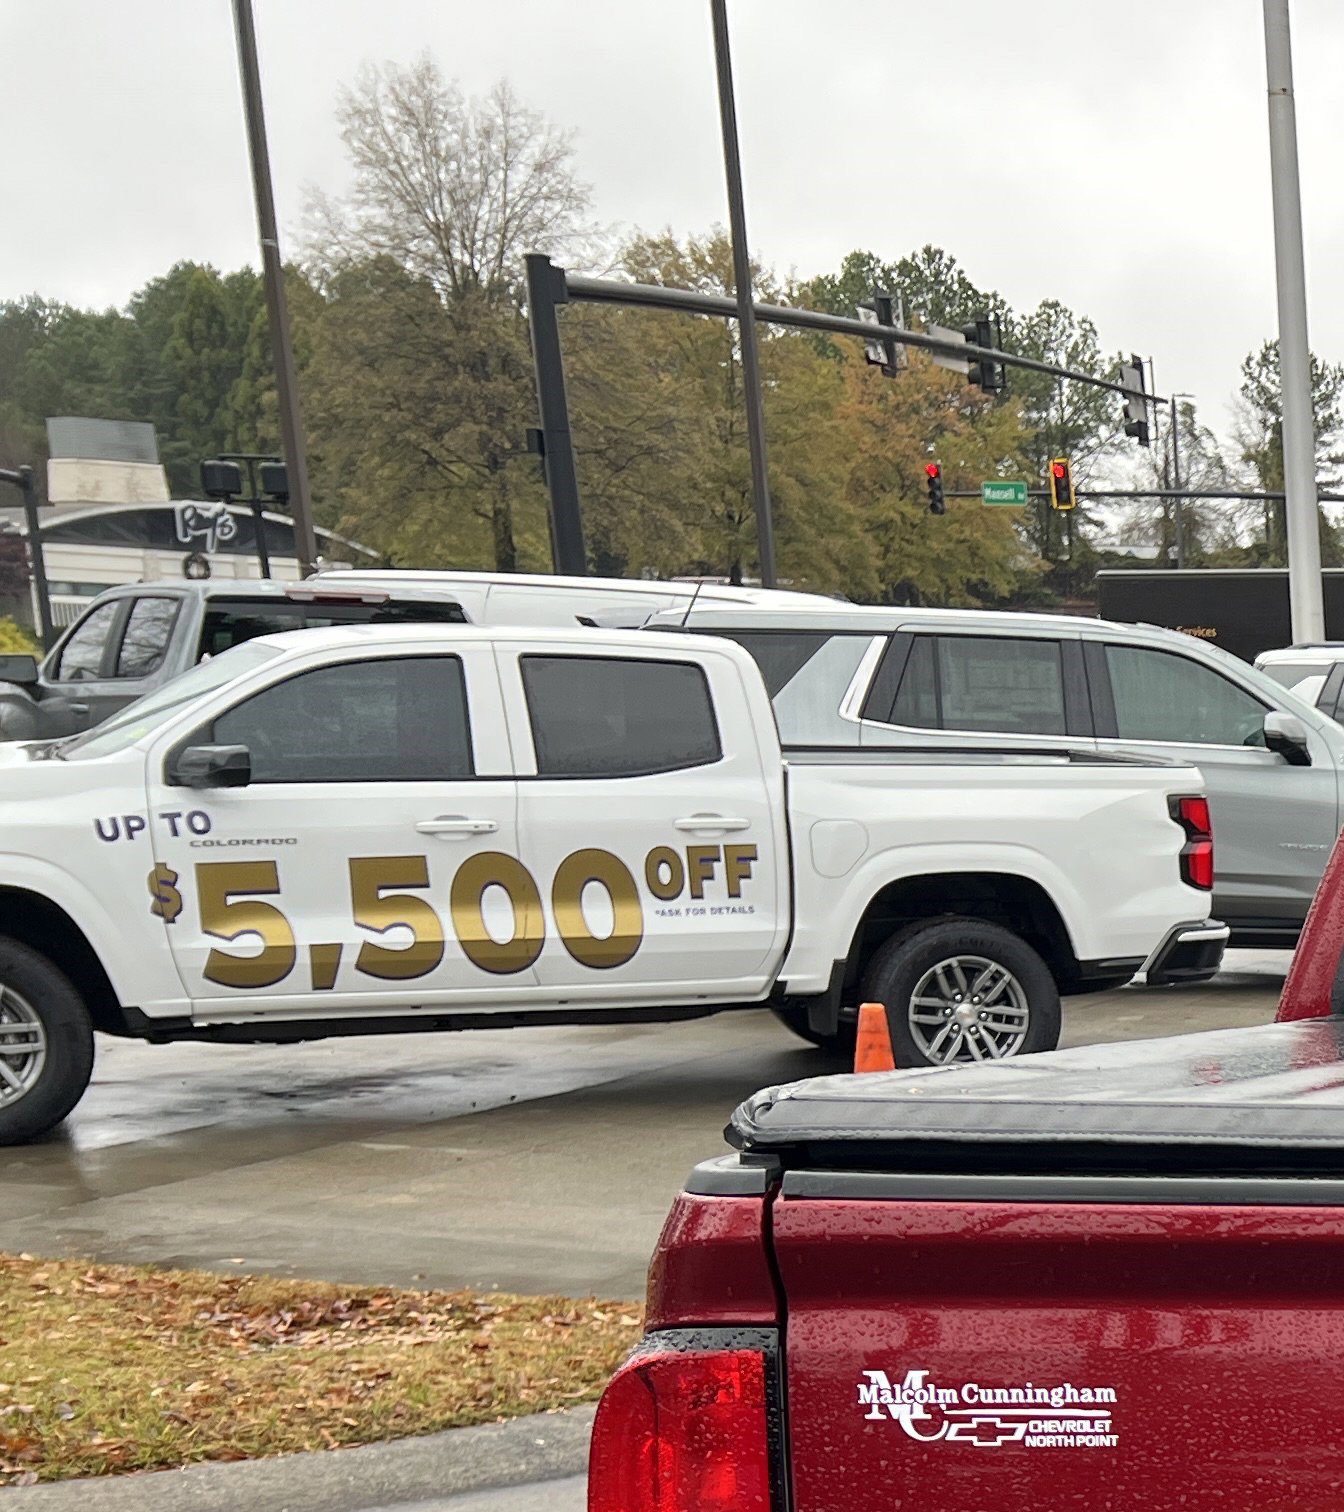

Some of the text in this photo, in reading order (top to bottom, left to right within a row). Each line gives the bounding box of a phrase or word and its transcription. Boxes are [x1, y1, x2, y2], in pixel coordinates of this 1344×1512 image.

[94, 810, 212, 842] UP TO
[189, 837, 298, 848] COLORADO
[644, 844, 758, 901] OFF
[686, 906, 706, 916] FOR
[710, 905, 756, 916] DETAILS
[857, 1382, 1118, 1407] Malcolm Cunningham
[1027, 1419, 1113, 1434] CHEVROLET
[1024, 1434, 1120, 1448] NORTH POINT
